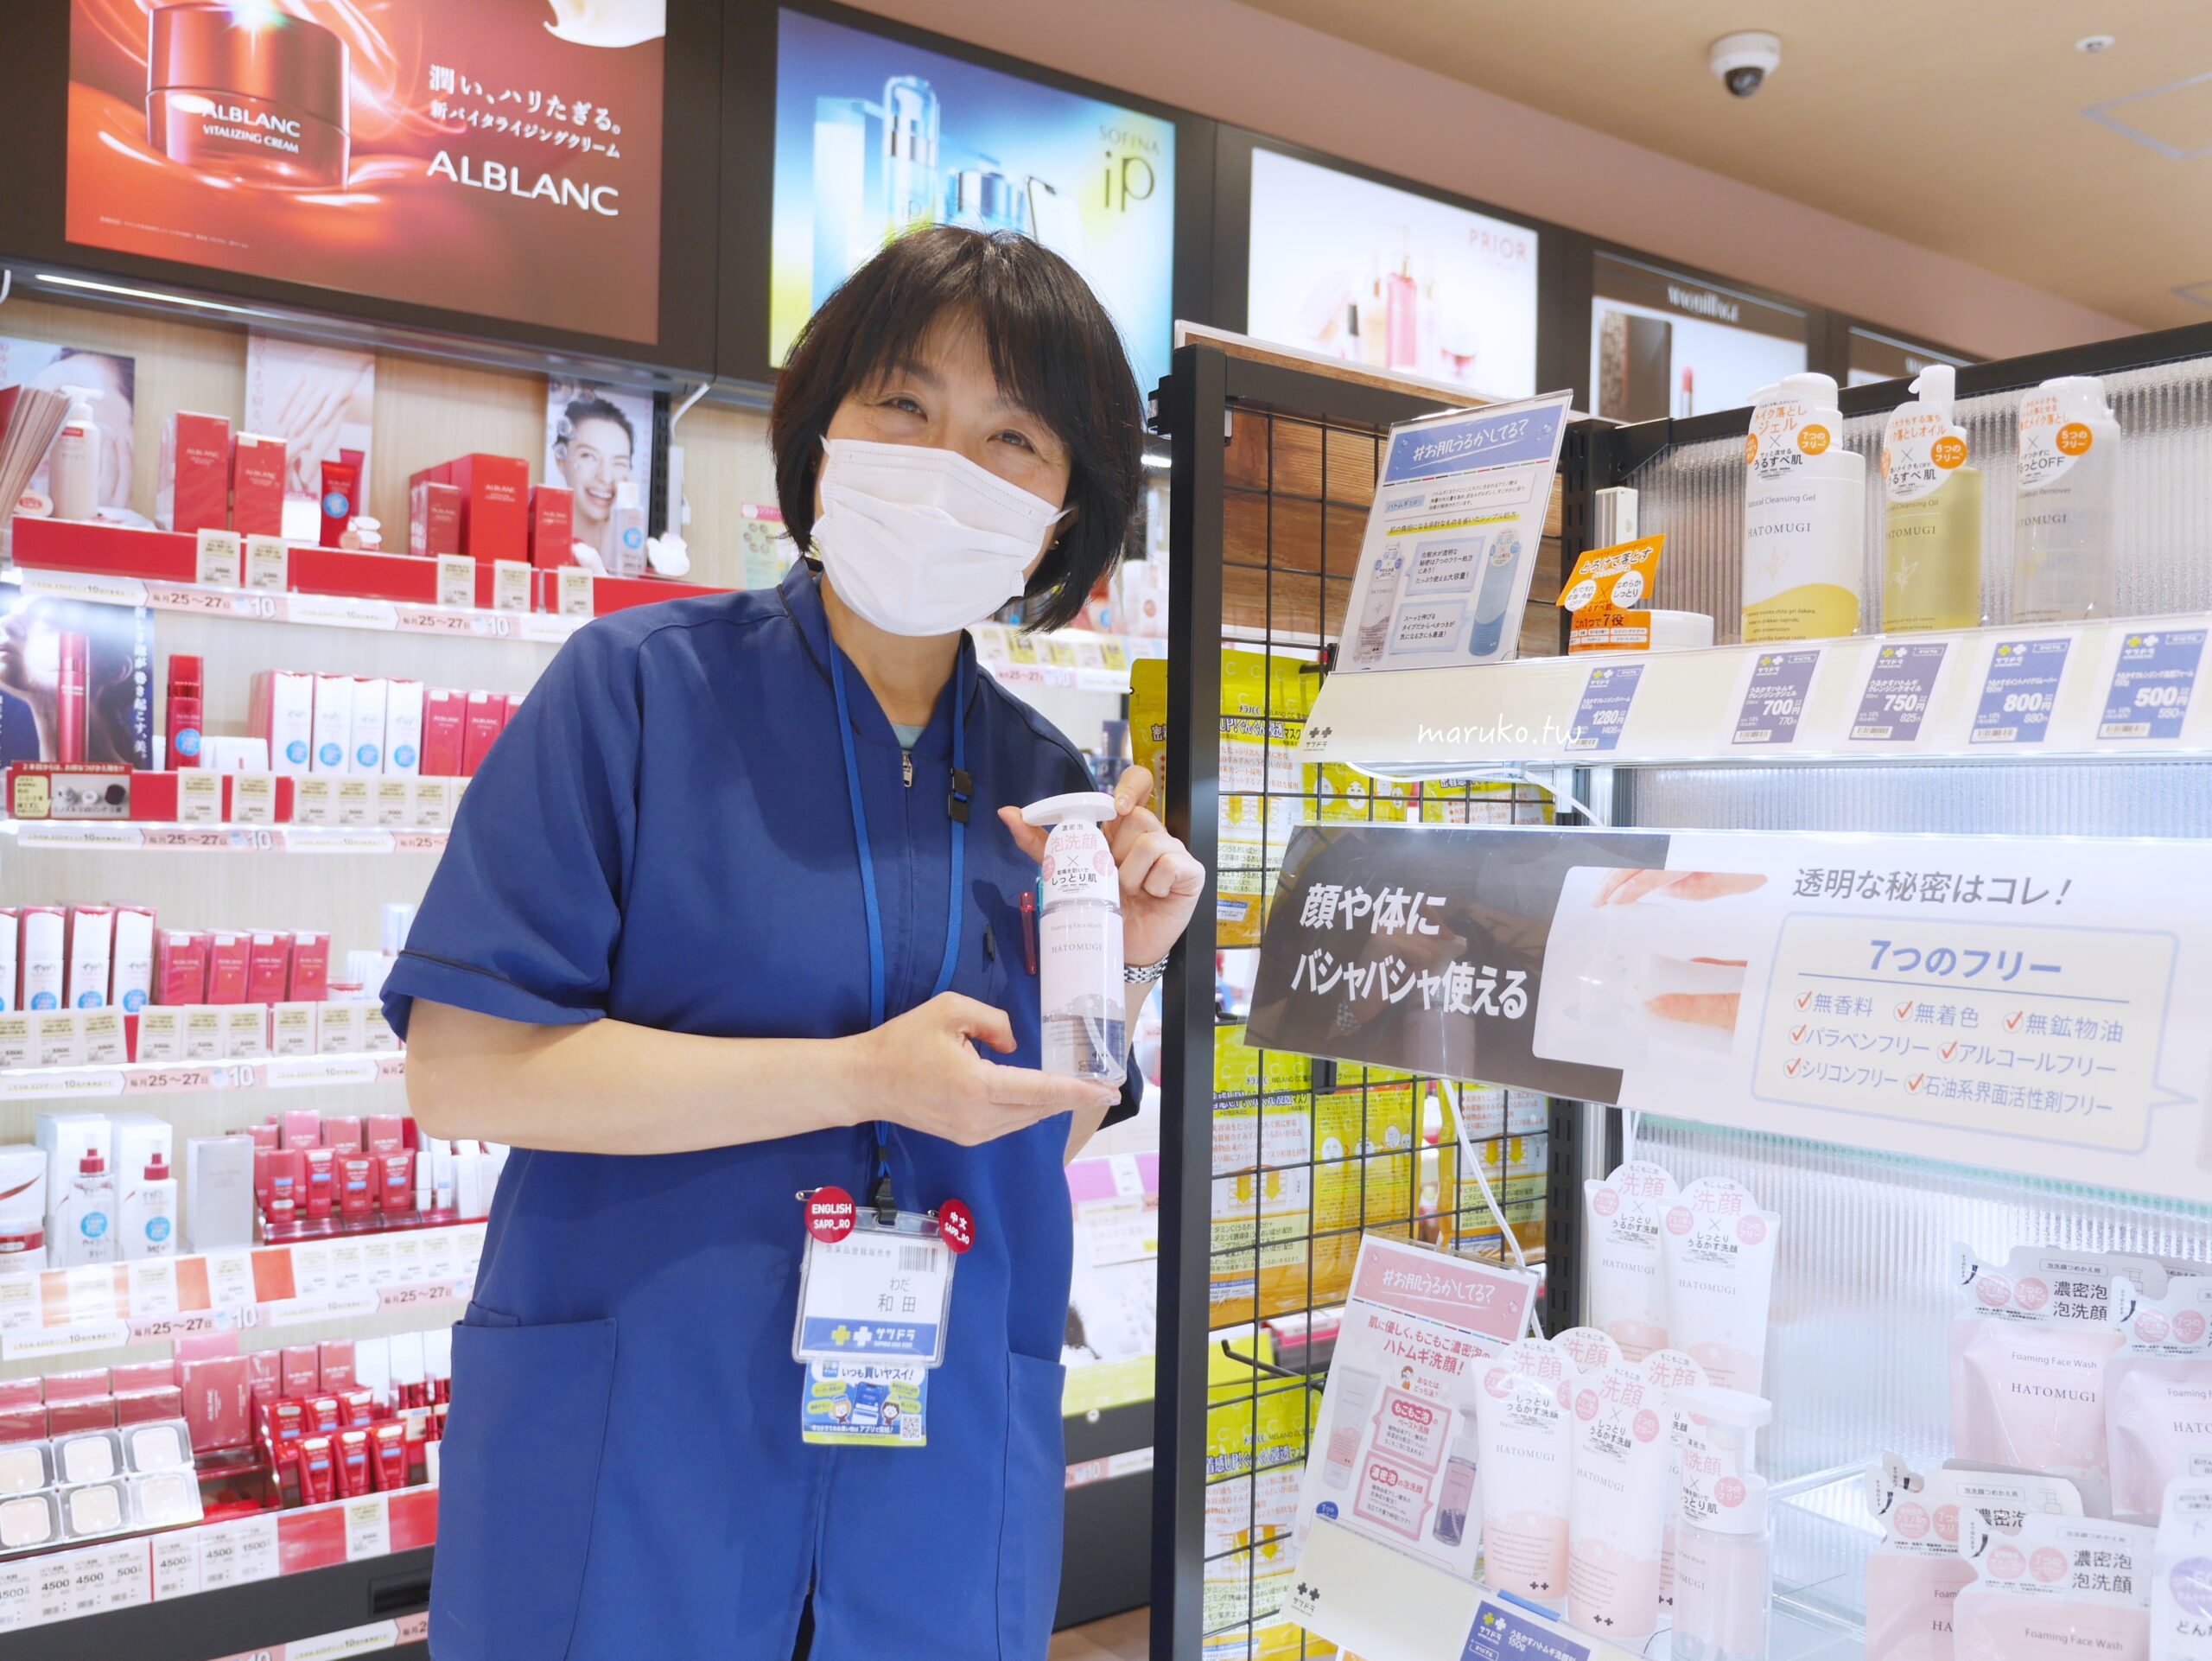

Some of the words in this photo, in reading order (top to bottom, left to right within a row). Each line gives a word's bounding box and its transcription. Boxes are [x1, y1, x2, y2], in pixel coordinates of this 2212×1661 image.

[429, 63, 621, 135] 潤い、ハリたぎる。
[201, 105, 301, 138] ALBLANC
[203, 124, 263, 144] VITALIZING
[264, 136, 300, 154] CREAM
[1098, 124, 1160, 156] SOFINA
[426, 150, 620, 216] ALBLANC
[1468, 228, 1529, 261] PRIOR
[1758, 418, 1798, 436] ジェル
[1802, 432, 1826, 441] 7つの
[2061, 430, 2088, 439] 5つの
[1936, 444, 1961, 453] 6つの
[1753, 455, 1803, 471] うるすべ肌
[1747, 522, 1811, 538] HATOMUGI
[1579, 545, 1654, 576] とろけて落とす
[1613, 588, 1639, 599] しっとり
[1883, 695, 1925, 712] 750円
[2003, 693, 2053, 712] 800円
[2134, 686, 2189, 707] 500円
[1762, 699, 1802, 716] 700円
[1051, 833, 1099, 854] 泡洗顔
[1052, 873, 1098, 887] しっとり肌
[1792, 867, 2073, 907] 透明な秘密はコレ!
[1300, 882, 1446, 936] 顔や体に
[1052, 943, 1103, 954] HATOMUGI
[1869, 939, 2063, 983] 7つのフリー
[1291, 948, 1529, 1020] バシャバシャ使える
[1813, 993, 1873, 1018] 無香料
[1914, 1002, 1980, 1029] 無着色
[2024, 1013, 2125, 1043] 無鉱物油
[1805, 1028, 1930, 1055] パラベンフリー
[1957, 1043, 2118, 1078] アルコールフリー
[1802, 1060, 1899, 1089] シリコンフリー
[1923, 1075, 2113, 1117] 石油系界面活性剤フリー
[1618, 1172, 1667, 1200] 洗顔
[811, 1203, 852, 1214] ENGLISH
[1691, 1187, 1744, 1218] 洗顔
[949, 1211, 969, 1230] 中文
[1611, 1219, 1659, 1236] うるかす洗顔
[1621, 1213, 1651, 1225] しっとり
[1687, 1238, 1738, 1254] うるかす洗顔
[1696, 1231, 1729, 1244] しっとり
[1602, 1257, 1656, 1276] HATOMUGI
[2046, 1262, 2101, 1275] 泡洗顔つめかえ用
[889, 1277, 912, 1292] わだ
[1382, 1268, 1496, 1304] #お肌うるかしてる?
[1679, 1279, 1737, 1295] HATOMUGI
[2018, 1282, 2044, 1295] 7つの
[2053, 1280, 2108, 1301] 濃密泡
[878, 1293, 917, 1313] 和田
[2052, 1301, 2108, 1321] 泡洗顔
[875, 1328, 916, 1340] サツドラ
[1383, 1339, 1465, 1376] ハトムギ洗顔!
[1563, 1338, 1611, 1368] 洗顔
[2012, 1351, 2050, 1366] Foaming
[2051, 1355, 2072, 1367] Face
[2074, 1358, 2098, 1370] Wash
[842, 1365, 914, 1380] いつも買いヤスイ!
[1511, 1349, 1565, 1382] 洗顔
[1649, 1360, 1697, 1390] 洗顔
[1417, 1376, 1440, 1390] あなたは
[1599, 1373, 1646, 1410] 洗顔
[2011, 1382, 2096, 1403] HATOMUGI
[1516, 1394, 1550, 1408] しっとり
[2167, 1387, 2207, 1400] Foaming
[1506, 1403, 1559, 1420] うるかす洗顔
[1598, 1418, 1626, 1437] しっとり
[1589, 1426, 1632, 1449] うるかす洗顔
[1496, 1444, 1556, 1462] HATOMUGI
[1577, 1467, 1625, 1493] HATOMUGI
[1719, 1482, 1742, 1493] 7つの
[2073, 1549, 2133, 1571] 濃密泡
[41, 1577, 71, 1592] 4500
[75, 1571, 105, 1585] 4500
[2072, 1572, 2133, 1595] 泡洗顔
[2024, 1627, 2069, 1645] Foaming
[2069, 1632, 2094, 1648] Face
[2095, 1634, 2124, 1652] Wash
